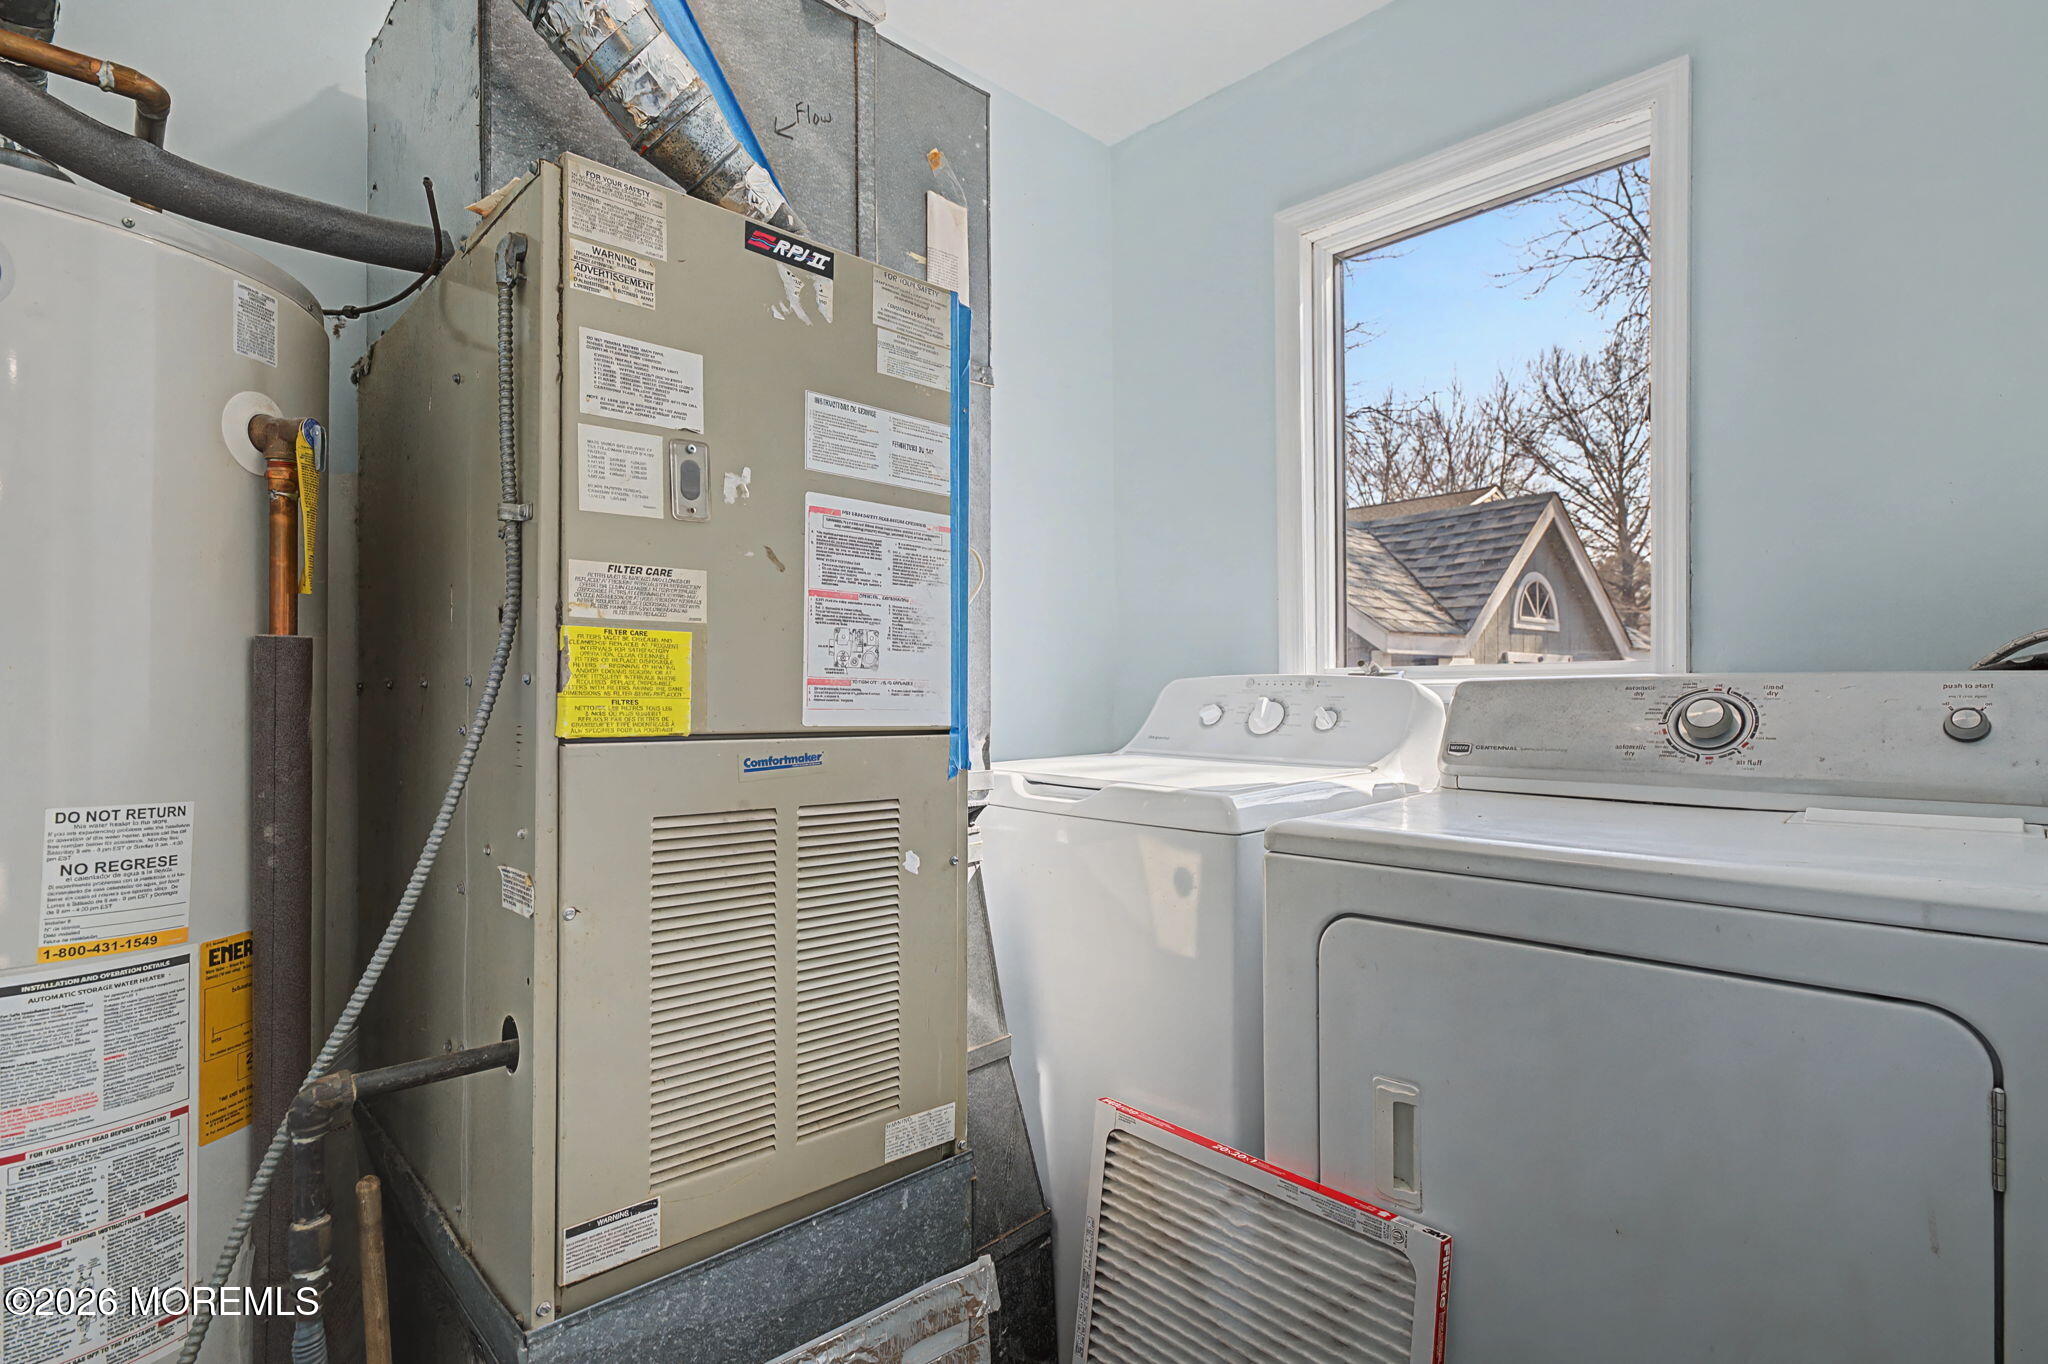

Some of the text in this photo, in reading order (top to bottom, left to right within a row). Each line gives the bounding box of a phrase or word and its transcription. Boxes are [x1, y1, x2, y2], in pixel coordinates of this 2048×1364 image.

[795, 101, 832, 126] Flow
[586, 170, 650, 197] FOR YOUR SAFETY
[592, 246, 637, 266] WARNING
[773, 240, 810, 261] RPJ
[574, 262, 654, 291] ADVERTISSEMENT
[884, 272, 897, 282] FOR
[917, 284, 939, 297] SAFETY
[608, 564, 673, 577] FILTER CARE
[744, 753, 823, 768] Comfortmaker
[55, 805, 186, 824] DO NOT RETURN
[60, 854, 178, 876] NO REGRESE
[42, 936, 158, 959] 1-800-431-1549
[21, 960, 170, 993] INSTALLATION AND OPERATION DETAILS
[27, 973, 165, 1005] AUTOMATIC STORAGE WATER HEATER
[29, 1151, 43, 1159] FOR
[45, 1145, 64, 1155] YOUR
[65, 1139, 90, 1152] SAFETY
[92, 1133, 109, 1144] READ
[110, 1125, 134, 1139] BEFORE
[597, 1210, 630, 1226] WARNING
[1422, 1228, 1449, 1240] 3M
[1439, 1243, 1451, 1309] Filtrete
[101, 1346, 109, 1354] TO
